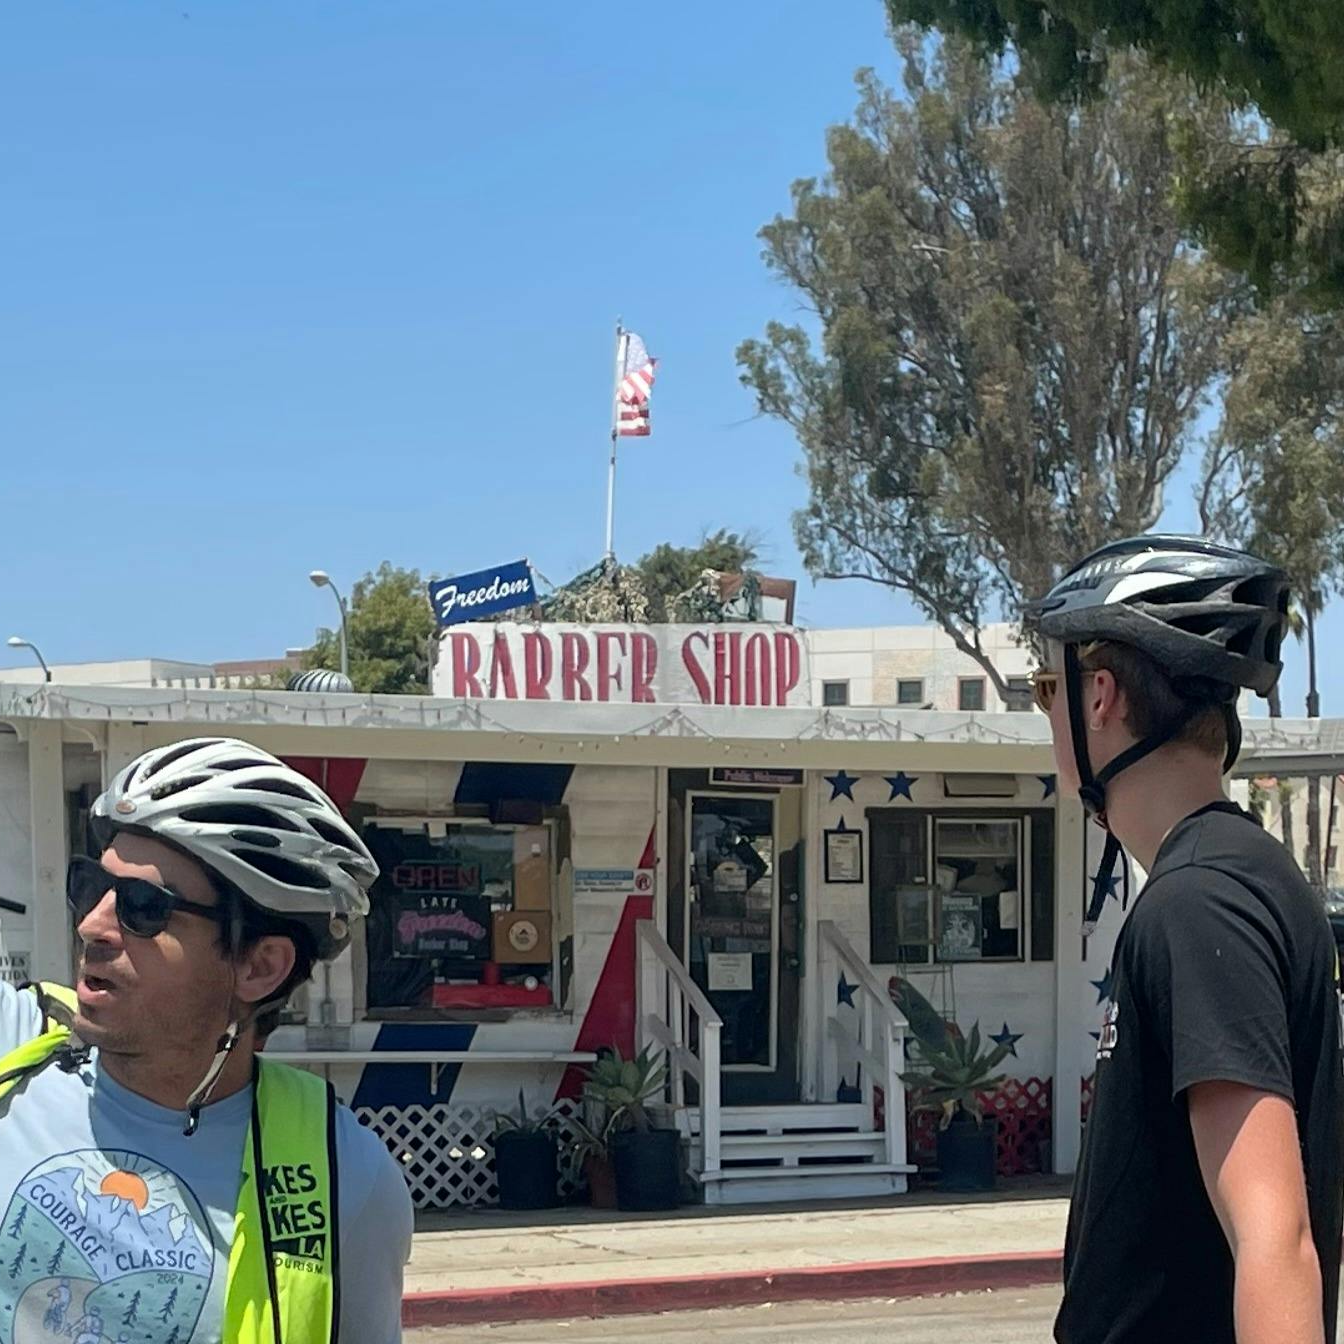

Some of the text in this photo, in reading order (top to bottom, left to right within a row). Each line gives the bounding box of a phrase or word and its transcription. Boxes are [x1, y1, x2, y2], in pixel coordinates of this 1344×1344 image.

[434, 576, 531, 619] Freedom
[450, 630, 800, 706] BARBER SHOP
[29, 1183, 197, 1272] COURAGE CLASSIC
[298, 1237, 323, 1259] LA
